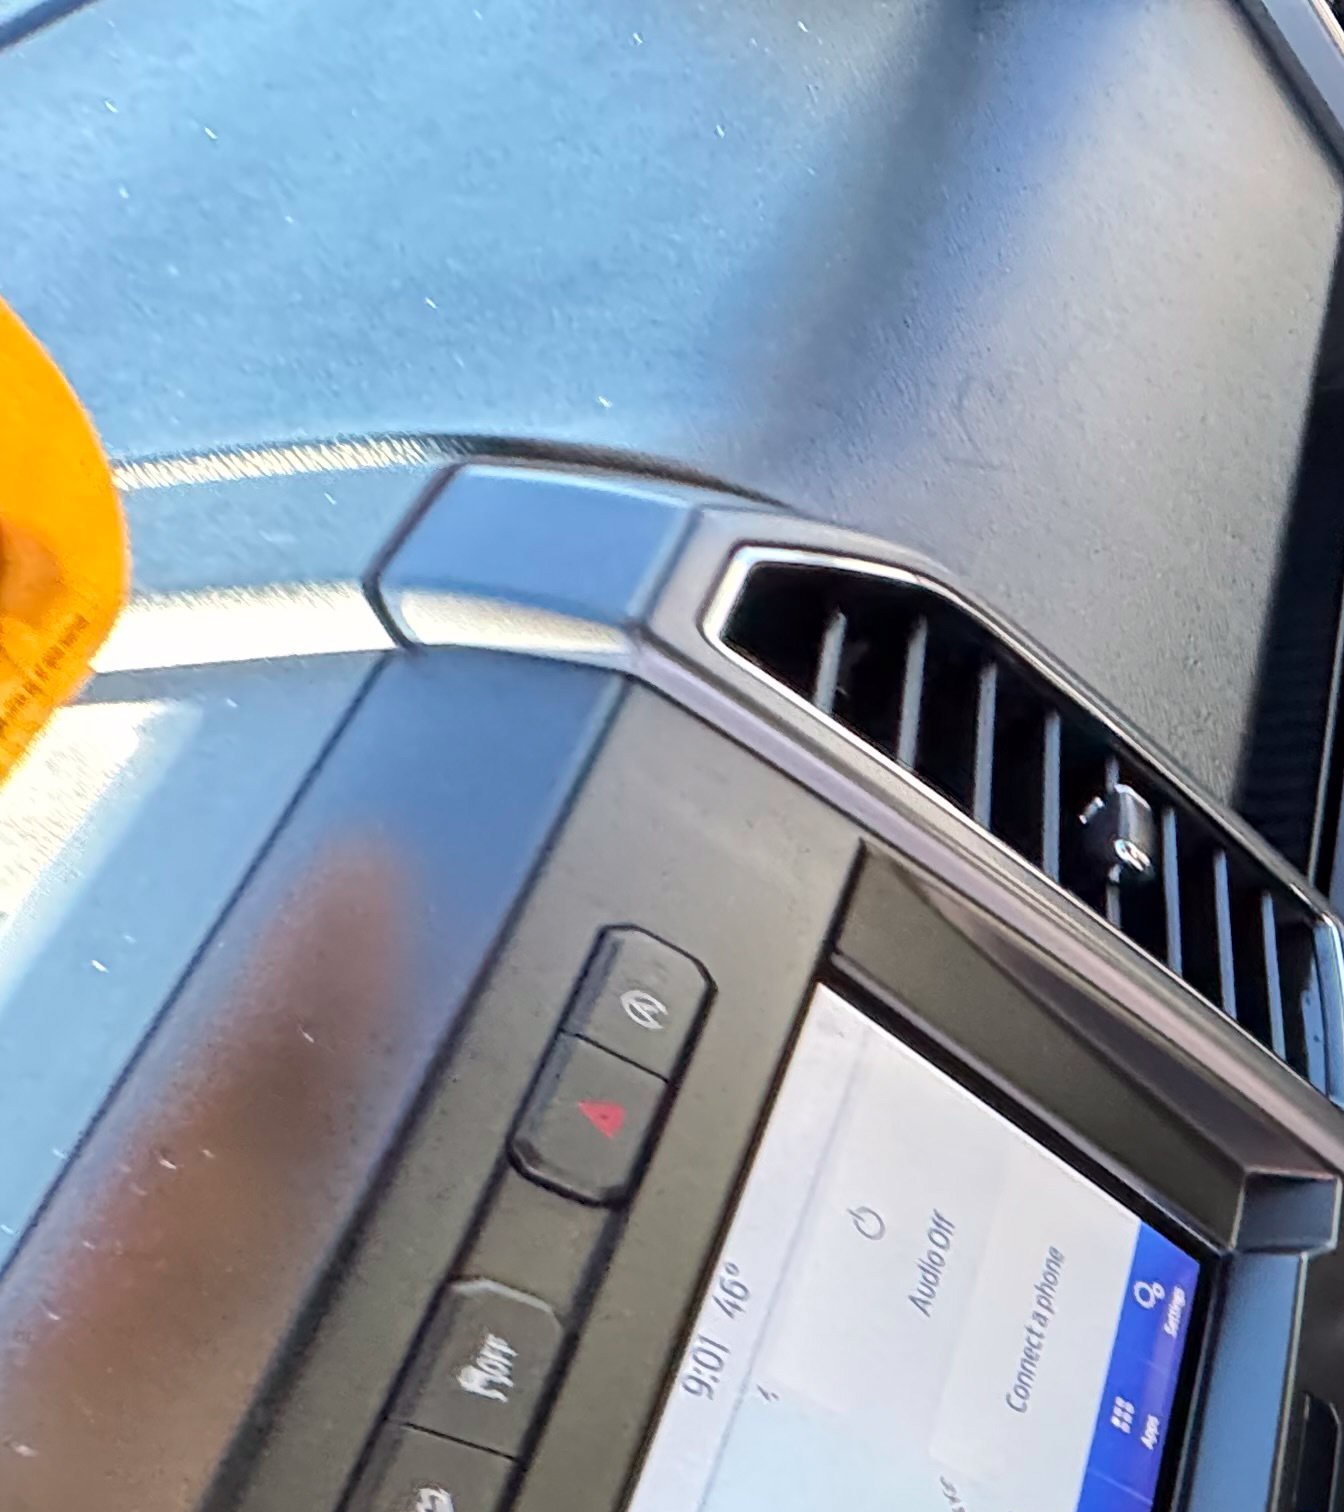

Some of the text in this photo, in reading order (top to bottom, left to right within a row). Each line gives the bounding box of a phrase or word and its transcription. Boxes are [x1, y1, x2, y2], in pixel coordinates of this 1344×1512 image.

[908, 1209, 956, 1318] Audio Off
[1005, 1246, 1066, 1414] Connect a phone
[1164, 1286, 1186, 1338] Settings
[682, 1335, 731, 1400] 9:01
[1141, 1415, 1160, 1450] Apps
